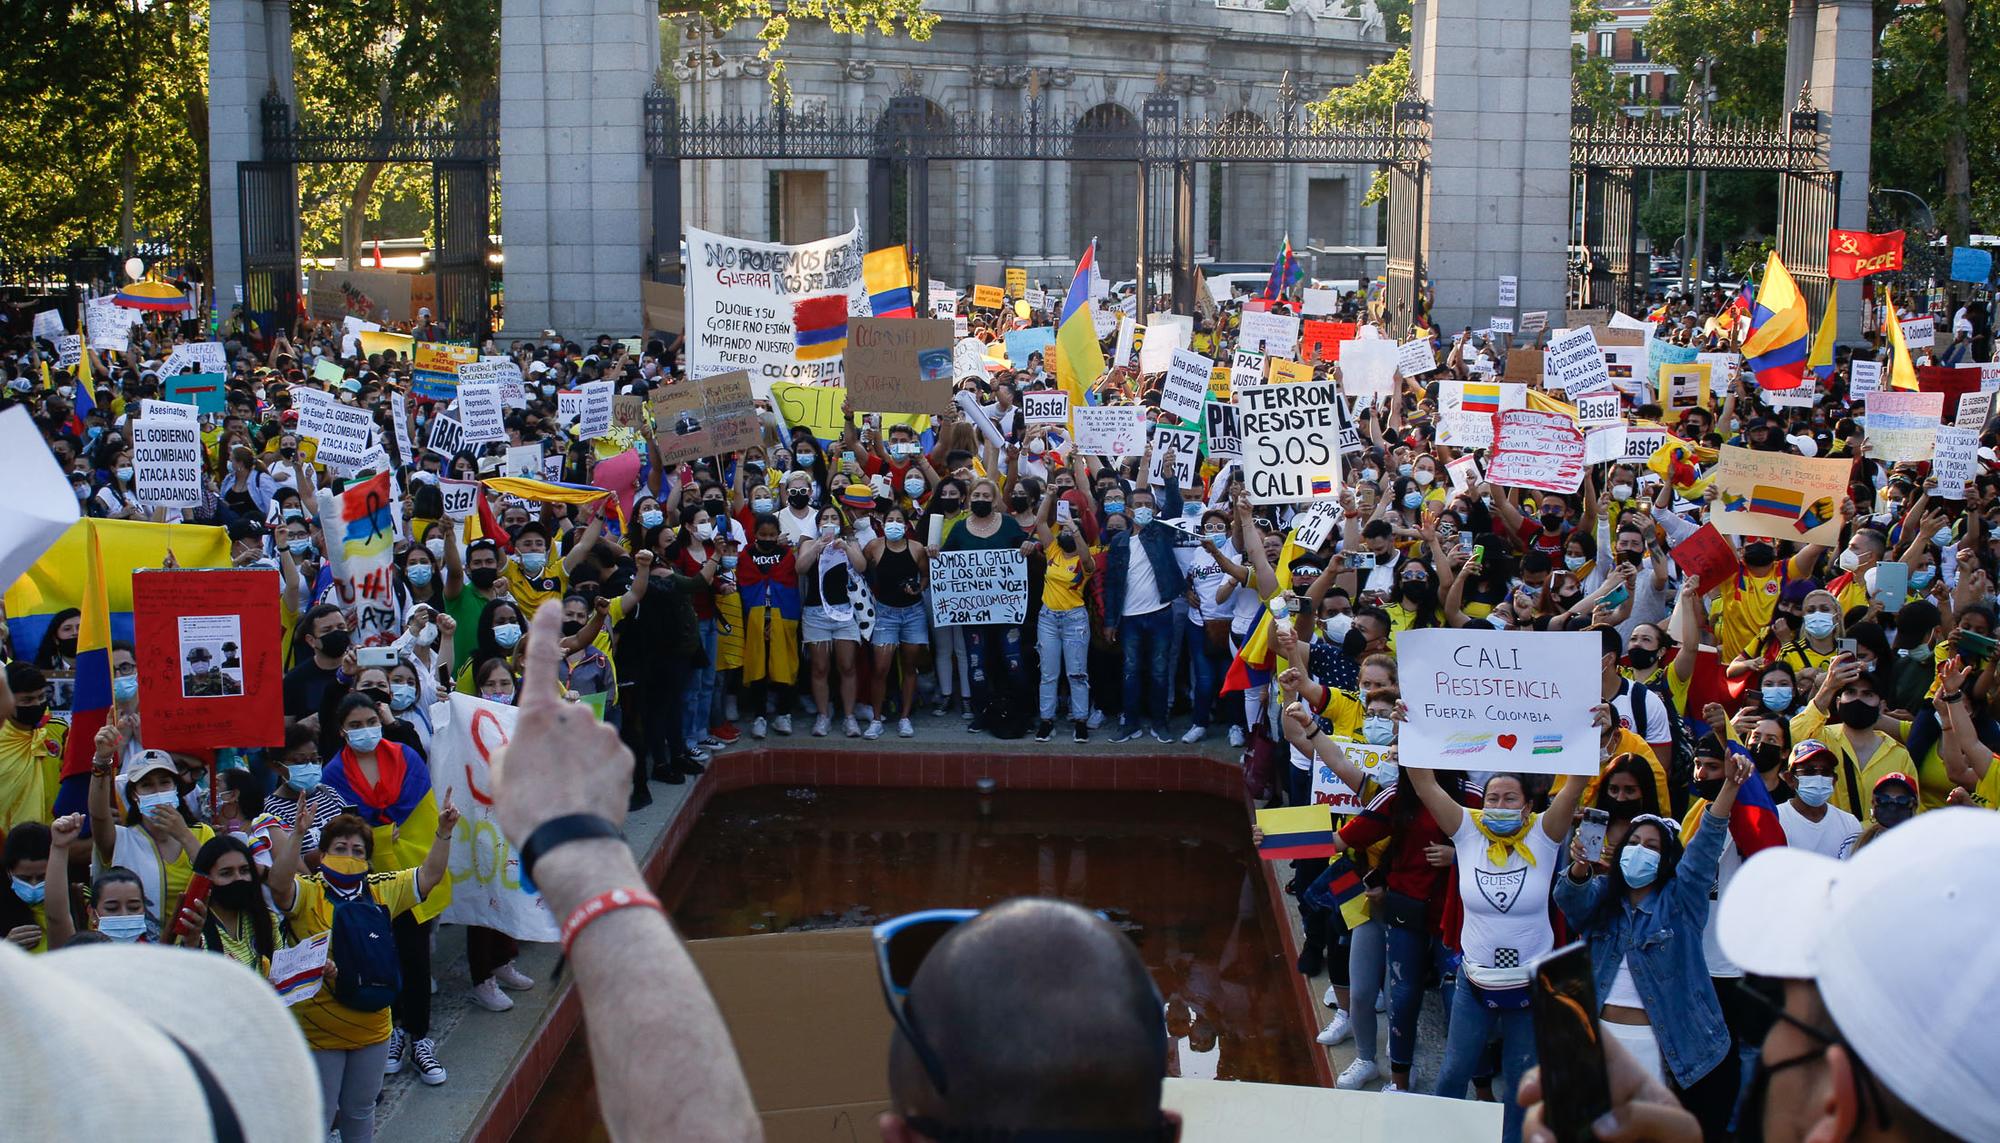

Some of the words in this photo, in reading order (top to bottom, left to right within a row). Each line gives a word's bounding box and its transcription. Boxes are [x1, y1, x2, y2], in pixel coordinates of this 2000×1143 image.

[705, 243, 737, 268] NO
[739, 248, 820, 274] PODEMOS
[1855, 251, 1896, 272] PCPE
[717, 268, 771, 289] GUERRA
[775, 272, 802, 294] NOS
[715, 301, 752, 317] DUQUE
[762, 307, 775, 319] SU
[938, 303, 953, 312] PAZ
[707, 317, 762, 333] GOBIERNO
[702, 333, 752, 349] MATANDO
[755, 340, 794, 353] NUESTRO
[1550, 347, 1560, 357] EL
[1559, 332, 1592, 352] GOBIERNO
[1236, 354, 1262, 371] PAZ
[1556, 345, 1597, 369] COLOMBIANO
[1172, 356, 1186, 370] Una
[1187, 361, 1208, 379] policía
[1563, 368, 1582, 381] ATACA
[1588, 358, 1602, 371] SUS
[1170, 375, 1202, 394] entrenada
[1163, 389, 1178, 403] para
[1178, 393, 1201, 411] guerra.
[1242, 383, 1335, 410] TERRON
[149, 405, 188, 419] Asesinatos,
[1025, 397, 1067, 416] Basta!
[1580, 397, 1619, 419] Basta!
[326, 409, 334, 419] EL
[335, 410, 369, 426] GOBIERNO
[1244, 407, 1332, 436] RESISTE
[1504, 414, 1542, 424] MALDITO
[134, 429, 146, 442] EL
[147, 429, 195, 443] GOBIERNO
[323, 423, 366, 440] COLOMBIANO
[1936, 435, 1945, 444] NO
[321, 438, 342, 449] ATACA
[349, 443, 362, 453] SUS
[1158, 432, 1196, 454] PAZ
[1210, 438, 1242, 452] JUST
[1258, 432, 1330, 466] S.O.S
[136, 449, 196, 462] COLOMBIANO
[1500, 453, 1537, 463] CONTRA
[139, 468, 169, 481] ATACA
[170, 468, 177, 481] A
[178, 468, 196, 481] SUS
[1252, 470, 1303, 497] CALI
[138, 488, 200, 501] CIUDADANOS!
[445, 488, 477, 510] sta!
[1309, 515, 1321, 528] TI
[1295, 525, 1320, 546] CALI
[931, 552, 966, 569] SOMOS
[968, 552, 983, 566] EL
[984, 549, 1024, 565] GRITO
[932, 570, 946, 580] DE
[951, 568, 973, 580] LOS
[976, 567, 998, 578] QUE
[1000, 566, 1014, 578] YA
[933, 582, 947, 593] NO
[946, 580, 993, 592] TIENEN
[1453, 645, 1522, 670] CALI
[1435, 671, 1561, 700] RESISTENCIA
[1424, 703, 1476, 720] FUERZA
[1485, 705, 1552, 722] COLOMBIA
[1480, 875, 1519, 886] GUESS
